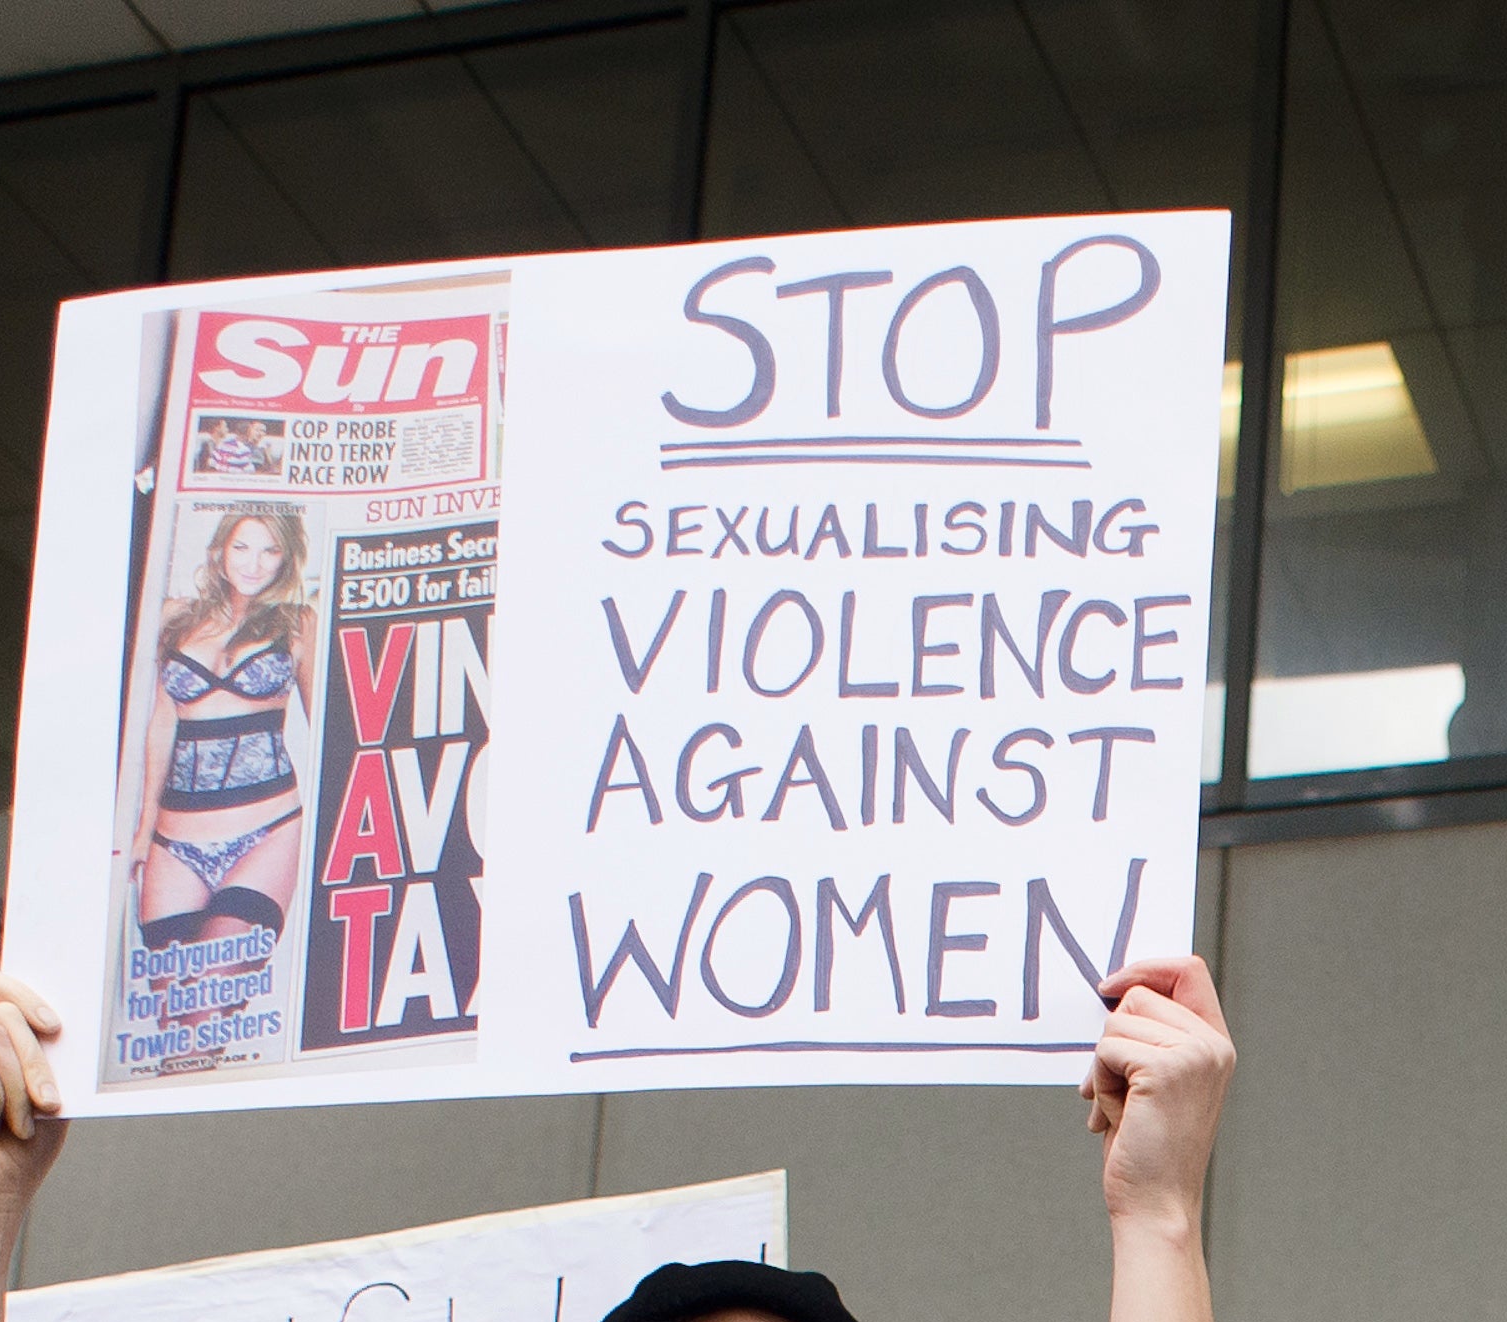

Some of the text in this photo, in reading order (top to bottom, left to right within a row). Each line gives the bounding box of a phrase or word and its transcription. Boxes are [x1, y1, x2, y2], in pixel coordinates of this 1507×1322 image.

[341, 325, 402, 344] THE
[661, 235, 1159, 430] STOP
[198, 319, 479, 404] Sun
[291, 442, 397, 463] INTO TERRY
[292, 420, 397, 440] COP PROBE
[288, 465, 389, 486] RACE ROW
[366, 497, 427, 523] SUN
[600, 497, 1159, 563] SEXUALISING
[342, 540, 444, 572] Business
[340, 576, 410, 611] £500
[417, 571, 451, 601] for
[602, 588, 1192, 698] VIOLENCE
[587, 715, 1156, 830] AGAINST
[130, 926, 276, 980] Bodyguards
[331, 876, 485, 1034] TA
[569, 858, 1146, 1028] WOMEN
[127, 966, 273, 1022] for battered
[116, 1009, 282, 1065] Towie sisters
